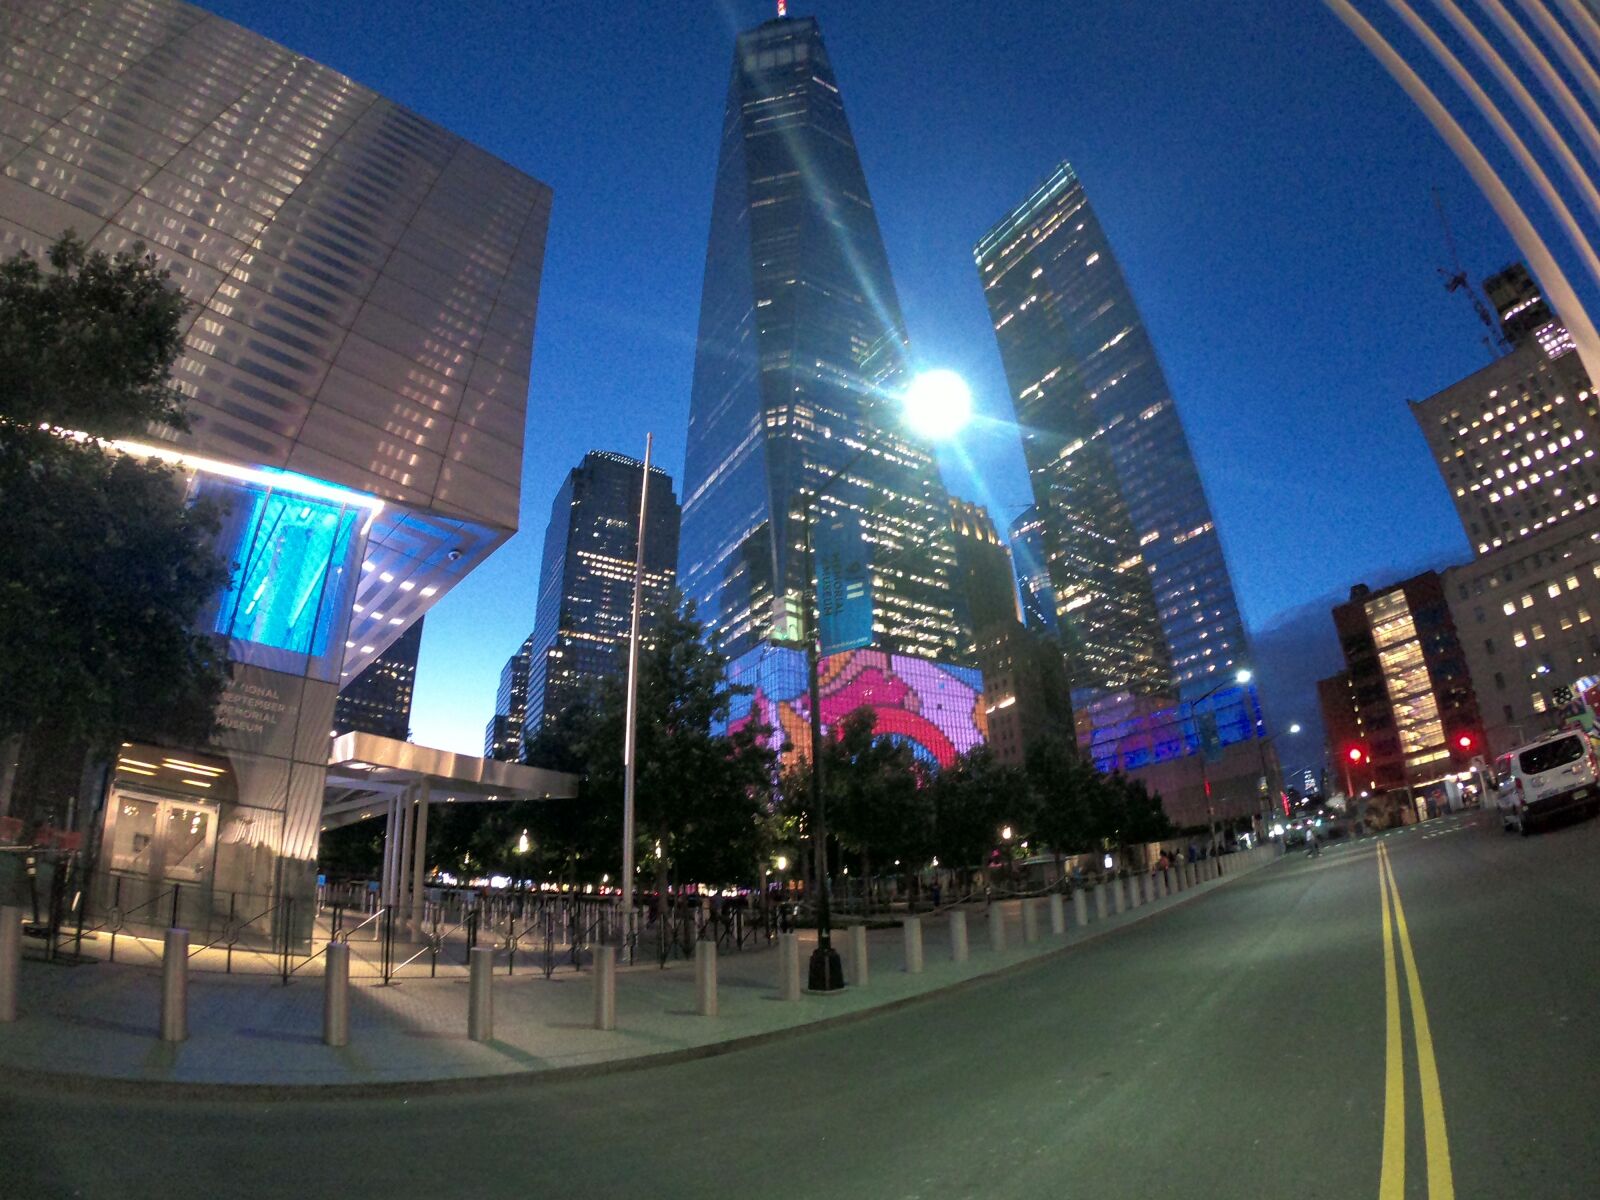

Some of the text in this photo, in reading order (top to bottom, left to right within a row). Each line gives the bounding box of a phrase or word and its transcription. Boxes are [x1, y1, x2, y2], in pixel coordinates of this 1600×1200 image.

[823, 565, 833, 616] MUSEUM
[832, 552, 844, 614] MEMORIAL
[224, 680, 279, 699] NTIONAL
[222, 691, 286, 713] SEPTEMBER
[214, 704, 277, 724] MEMORIAL
[215, 717, 263, 733] MUSEUM
